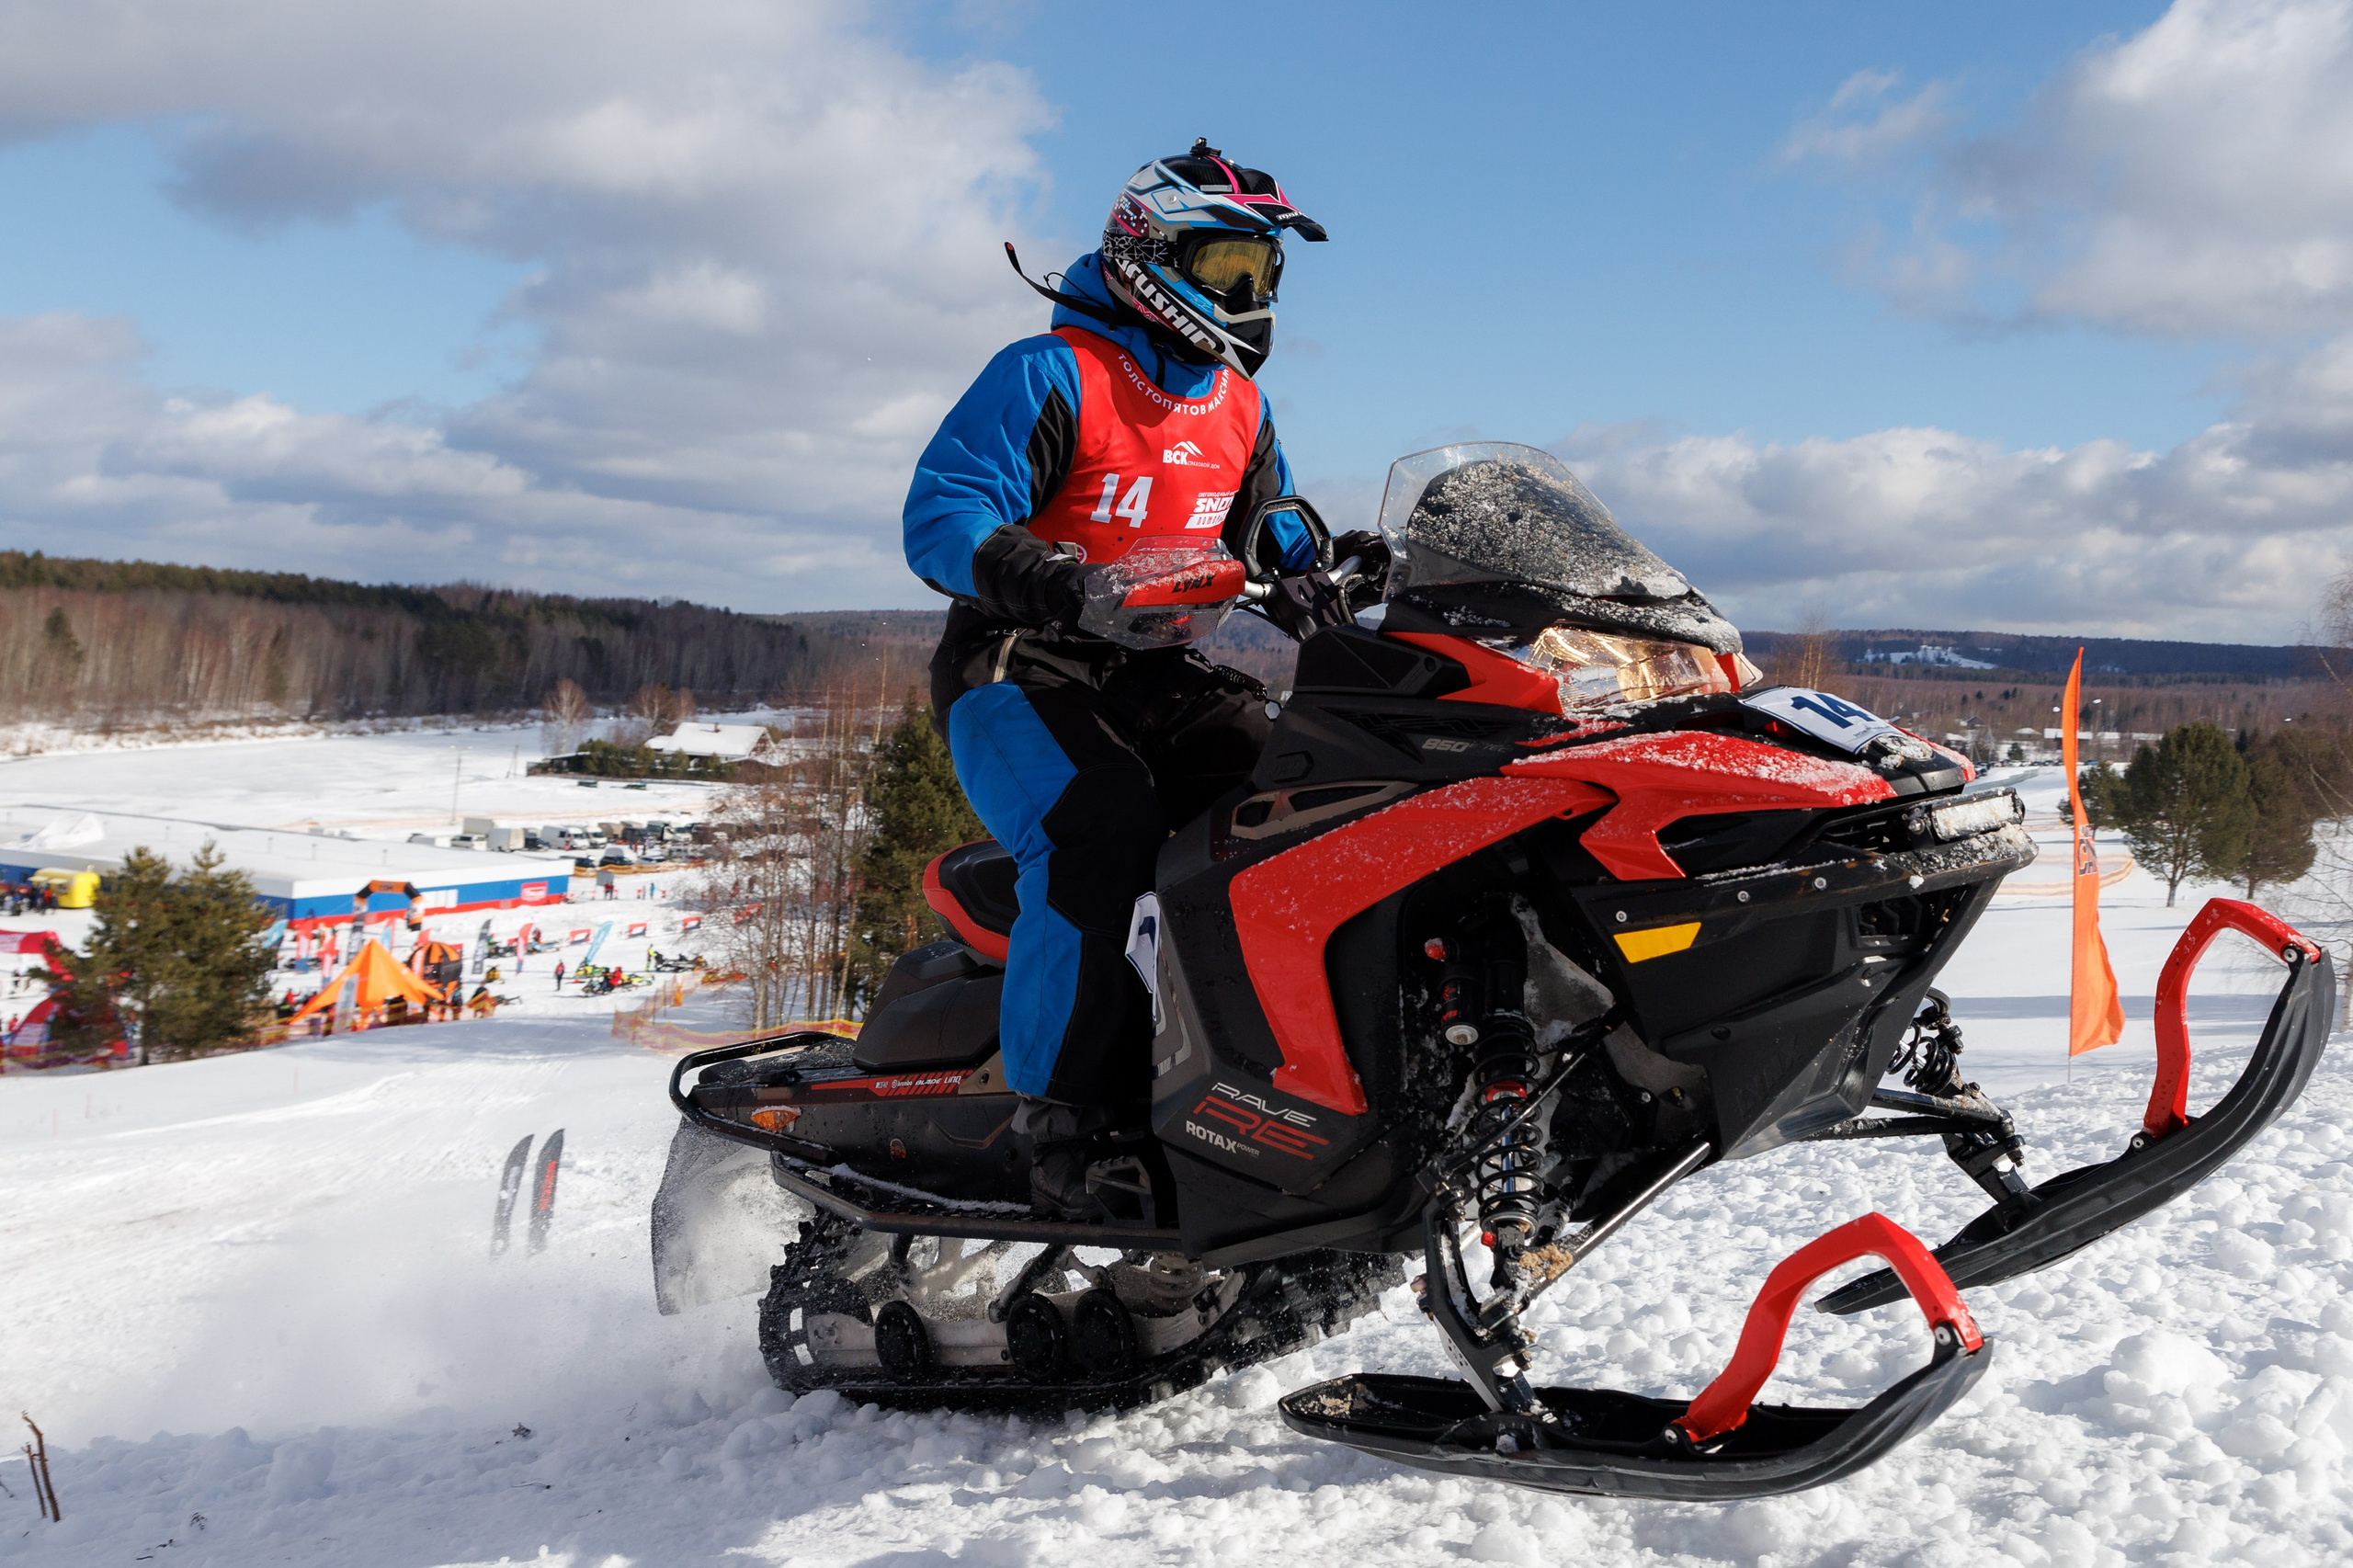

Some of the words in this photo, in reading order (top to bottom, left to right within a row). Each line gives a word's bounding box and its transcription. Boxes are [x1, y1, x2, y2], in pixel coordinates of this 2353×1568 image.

[1119, 353, 1206, 415] ТОЛСТОПЯТОВ
[1208, 369, 1230, 413] МАКСИМ
[1163, 449, 1188, 465] ВСК
[1090, 472, 1154, 528] 14
[1171, 574, 1215, 593] LYNX
[1790, 693, 1876, 730] 14
[1422, 738, 1470, 753] 850
[915, 1077, 942, 1085] BLADE
[1211, 1082, 1317, 1128] RAVE
[1186, 1119, 1237, 1154] ROTAX
[1236, 1142, 1260, 1156] POWER
[1193, 1095, 1330, 1161] RE
